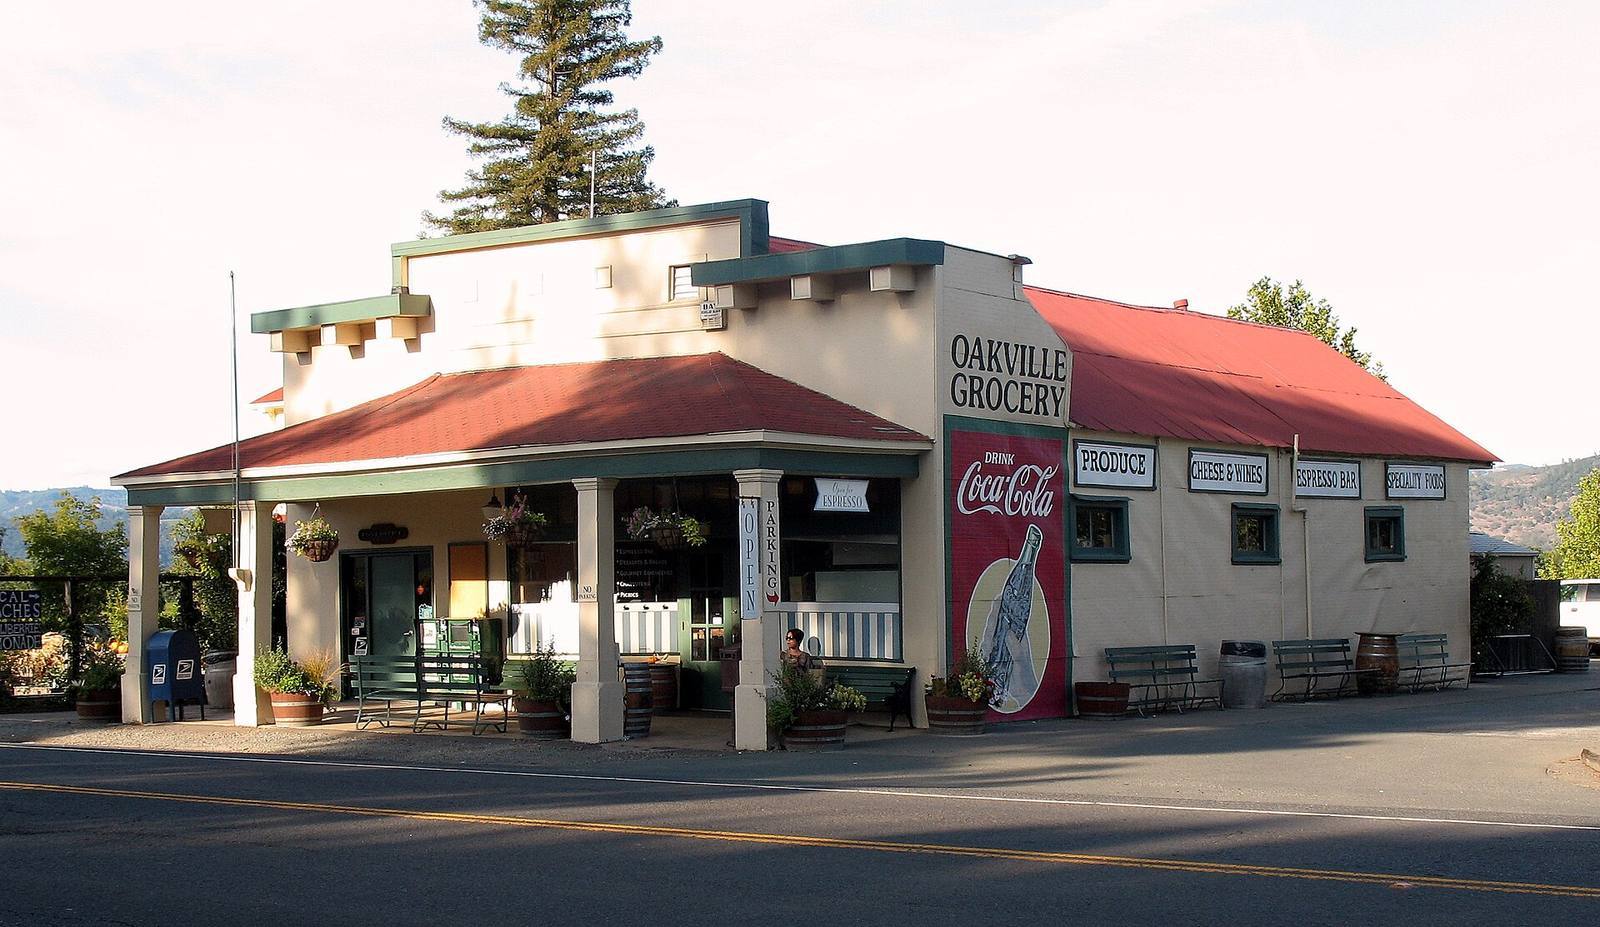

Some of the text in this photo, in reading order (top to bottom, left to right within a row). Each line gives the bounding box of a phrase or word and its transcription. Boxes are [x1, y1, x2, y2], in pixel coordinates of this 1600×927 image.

[951, 334, 1067, 382] OAKVILLE
[951, 372, 1065, 417] GROCERY
[985, 451, 1015, 465] DRINK
[1081, 449, 1146, 475] PRODUCE
[1191, 460, 1263, 484] CHEESE & WINES
[1296, 468, 1357, 489] ESPRESSO BAR
[1424, 472, 1444, 490] FOODS
[957, 462, 1059, 517] Coca-Cola
[823, 494, 863, 508] ESPRESSO
[766, 501, 778, 589] PARKING
[744, 512, 756, 611] OPEN
[583, 585, 592, 594] NO
[0, 603, 40, 617] CHES
[0, 635, 41, 649] ONADE
